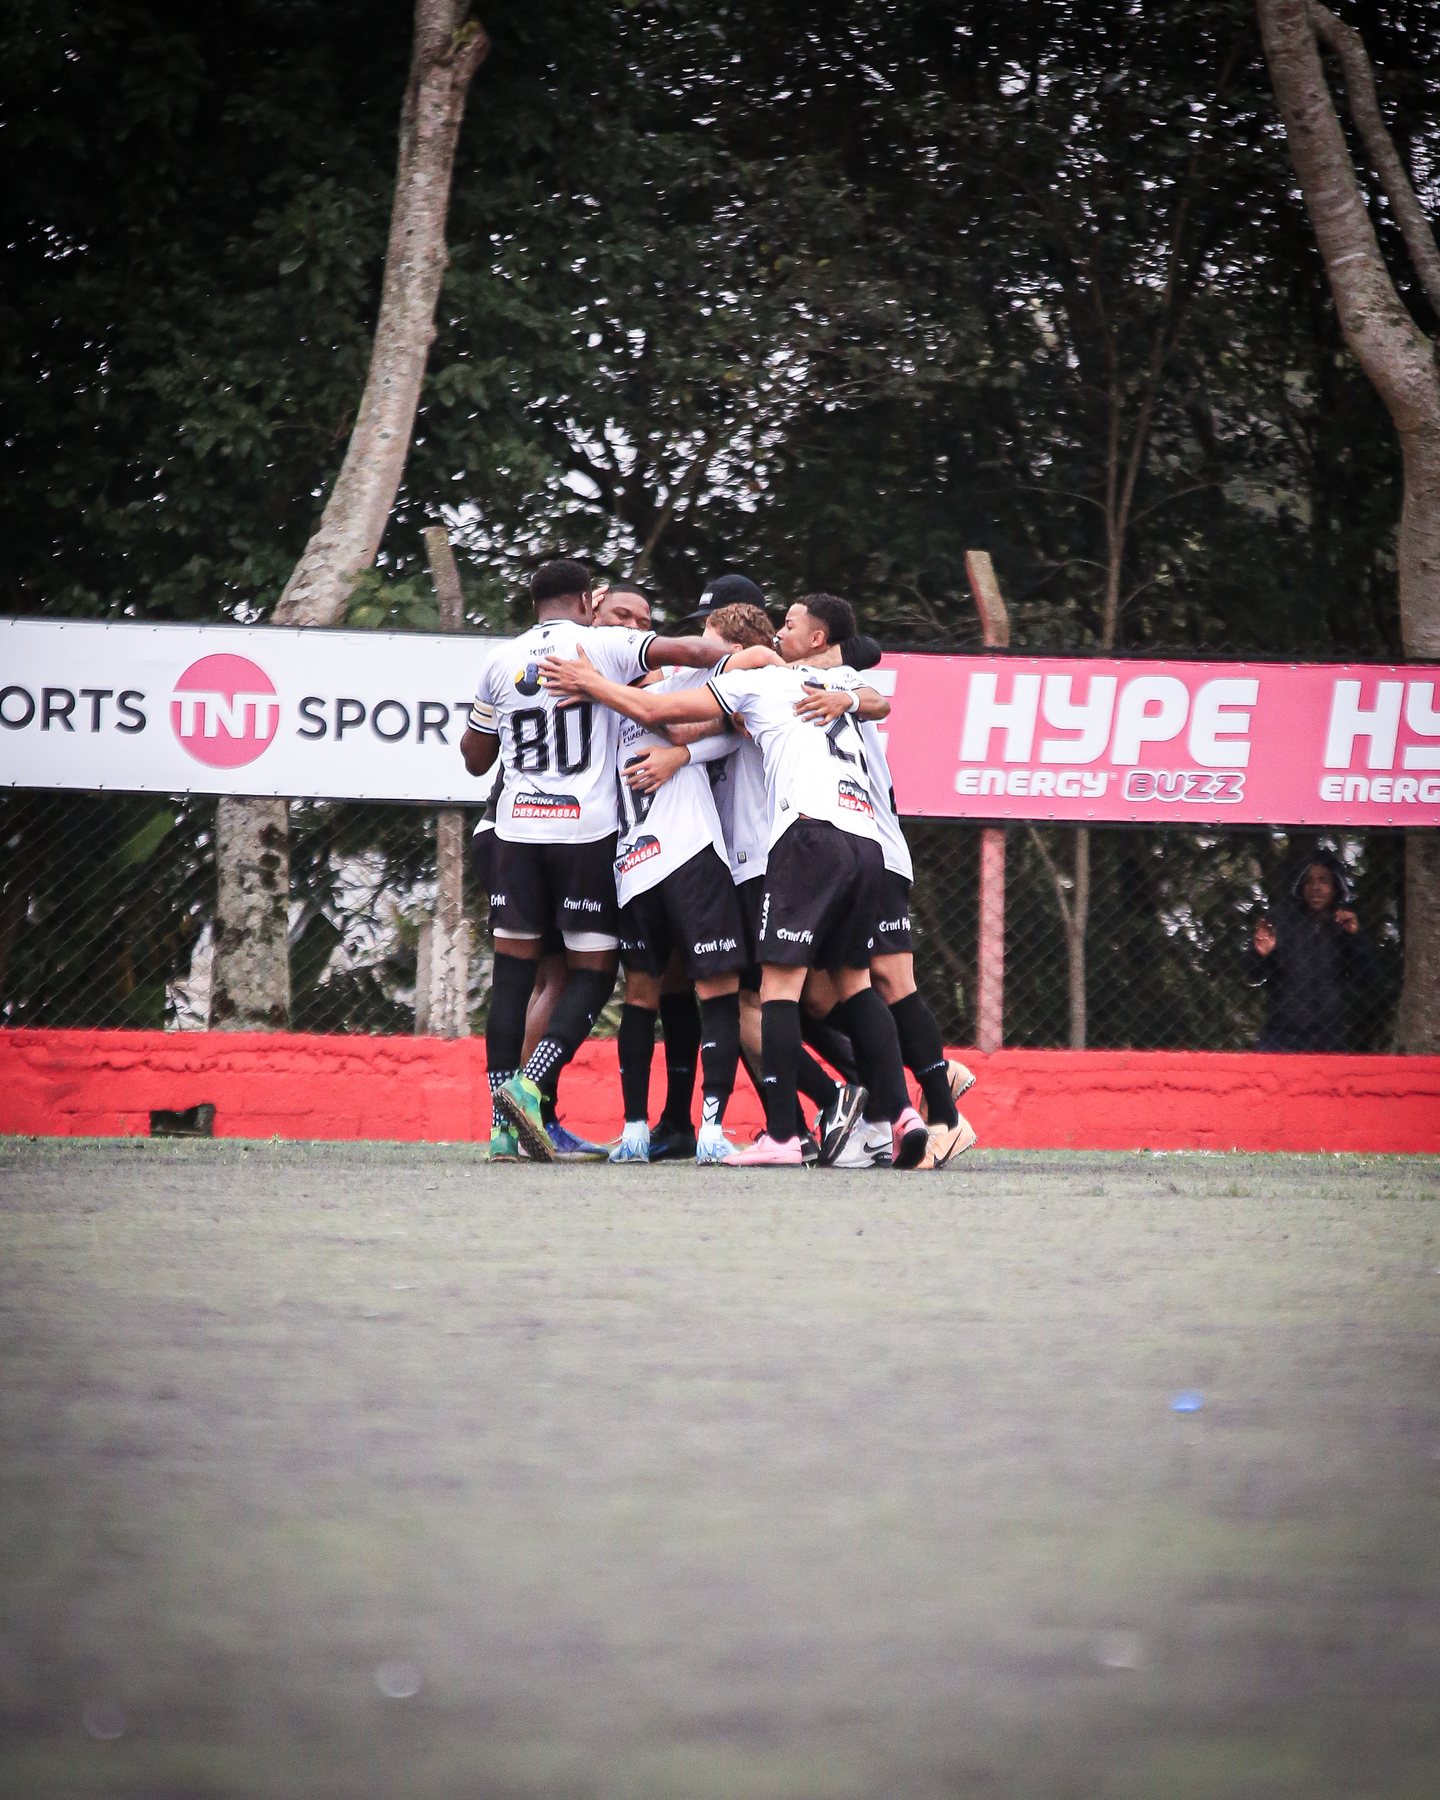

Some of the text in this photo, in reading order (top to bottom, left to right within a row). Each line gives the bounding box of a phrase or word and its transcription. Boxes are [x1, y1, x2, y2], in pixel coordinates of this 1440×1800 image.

[0, 685, 146, 734] ORTS
[172, 691, 280, 740] TNT
[959, 673, 1260, 768] HYPE
[511, 700, 593, 776] 80
[516, 795, 554, 805] OFICINA
[955, 769, 1246, 803] ENERGY BUZZ
[513, 808, 578, 817] DESAMASSA
